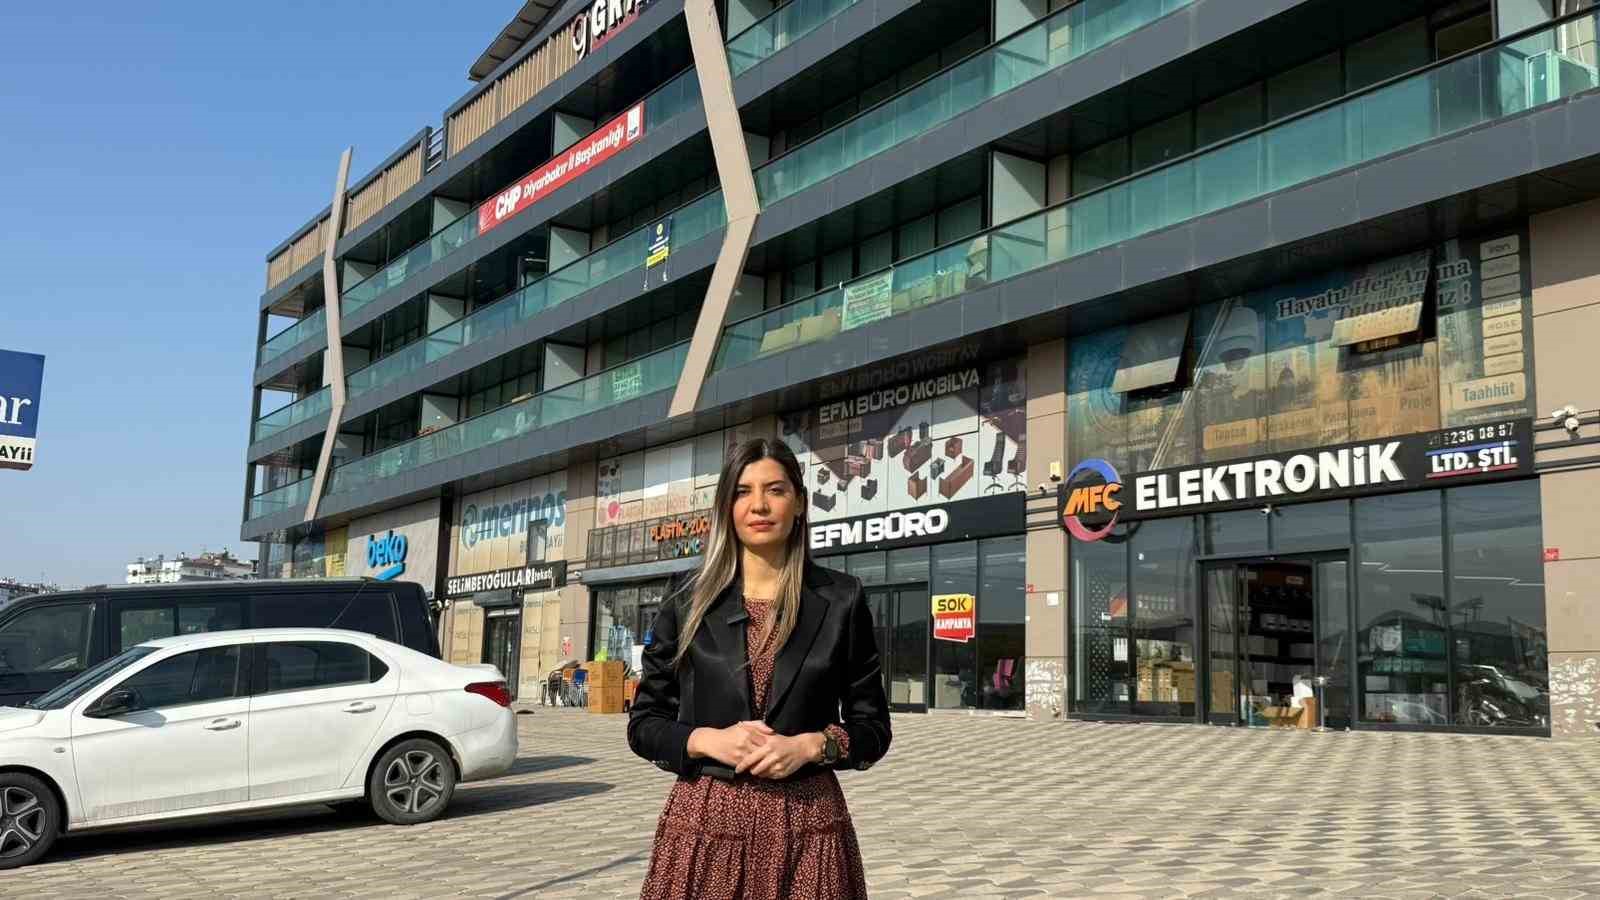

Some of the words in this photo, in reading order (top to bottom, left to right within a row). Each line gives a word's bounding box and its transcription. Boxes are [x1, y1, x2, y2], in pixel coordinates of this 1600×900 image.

[495, 185, 521, 221] CHP
[818, 399, 857, 426] EFM
[857, 386, 910, 414] BÜRO
[1462, 381, 1516, 403] Taahhüt
[1432, 453, 1475, 473] LTD.
[479, 491, 567, 541] merinos
[1063, 482, 1122, 515] MFC
[809, 524, 863, 550] EFM
[865, 508, 949, 542] BÜRO
[366, 530, 407, 567] beko
